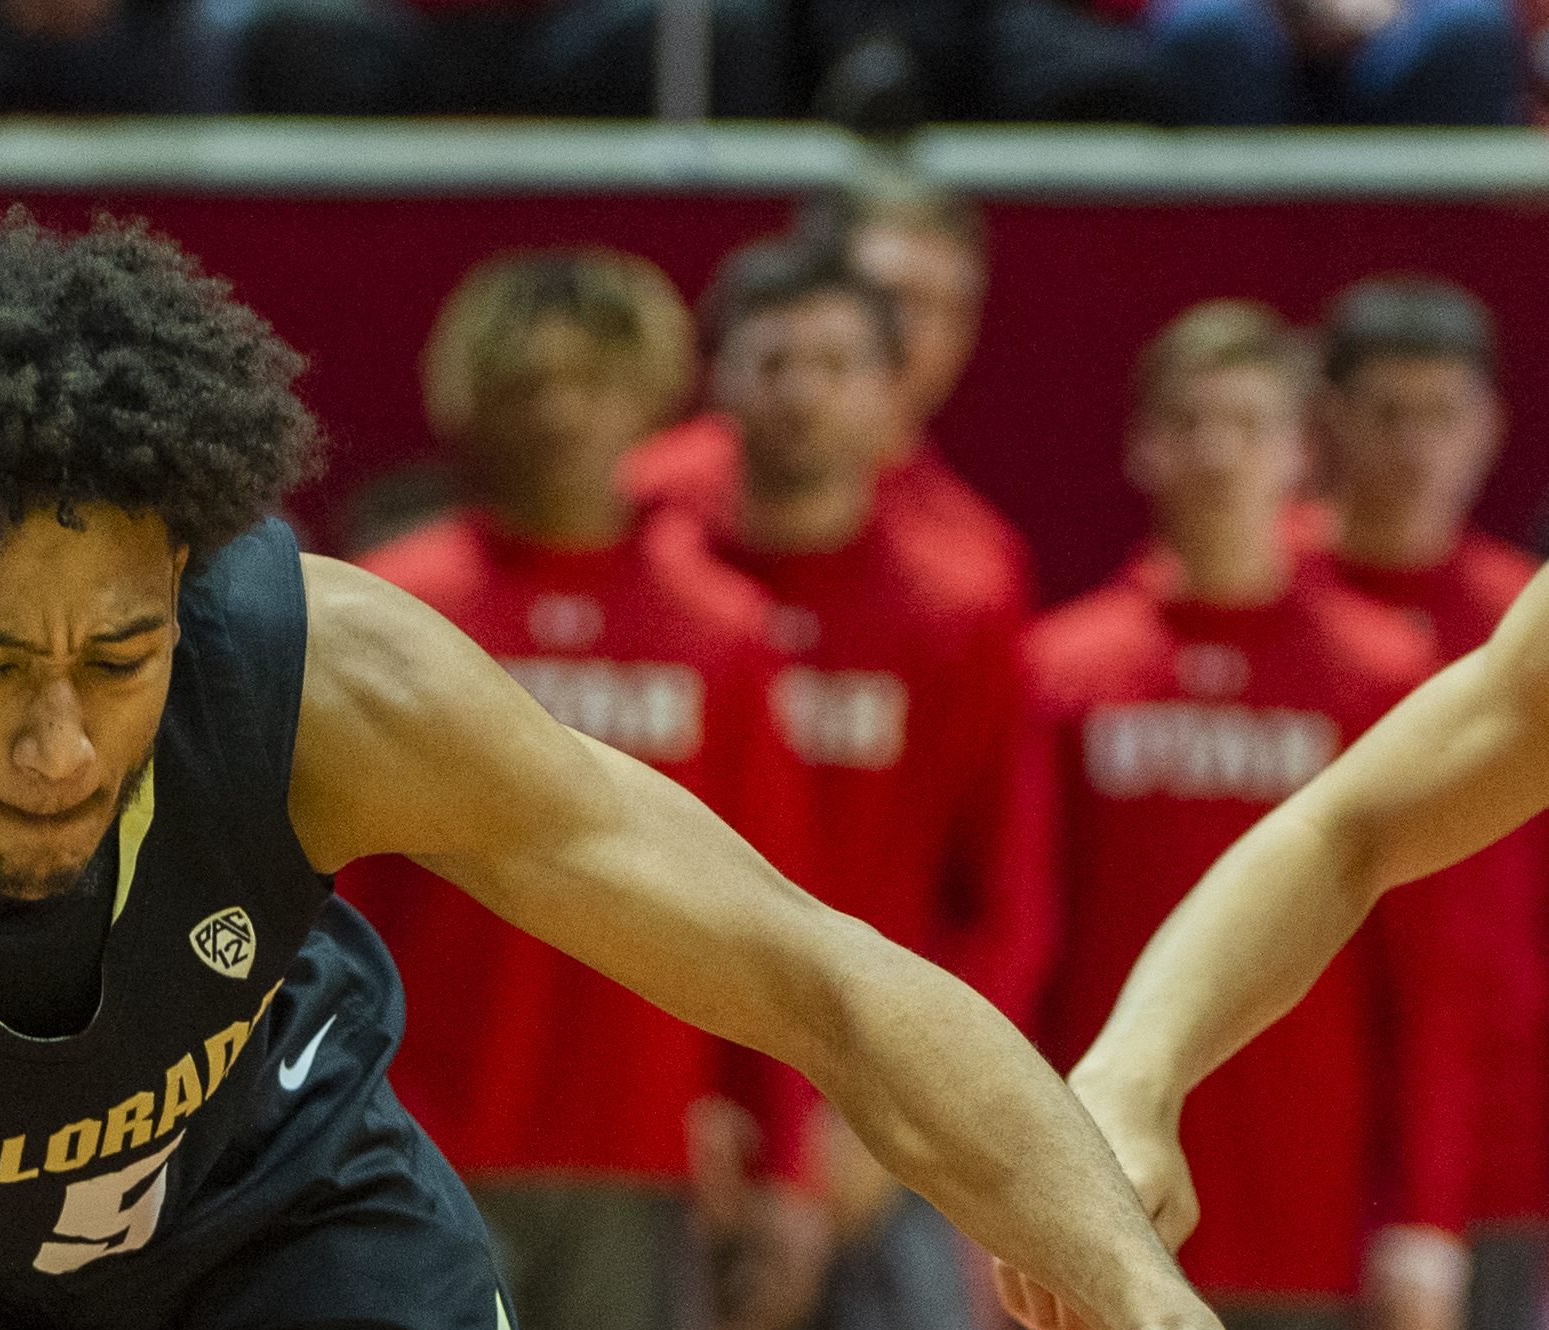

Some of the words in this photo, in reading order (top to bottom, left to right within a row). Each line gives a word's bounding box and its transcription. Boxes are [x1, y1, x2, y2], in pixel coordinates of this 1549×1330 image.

[195, 910, 251, 963] PAC
[218, 938, 249, 970] 12
[32, 1127, 187, 1275] 5
